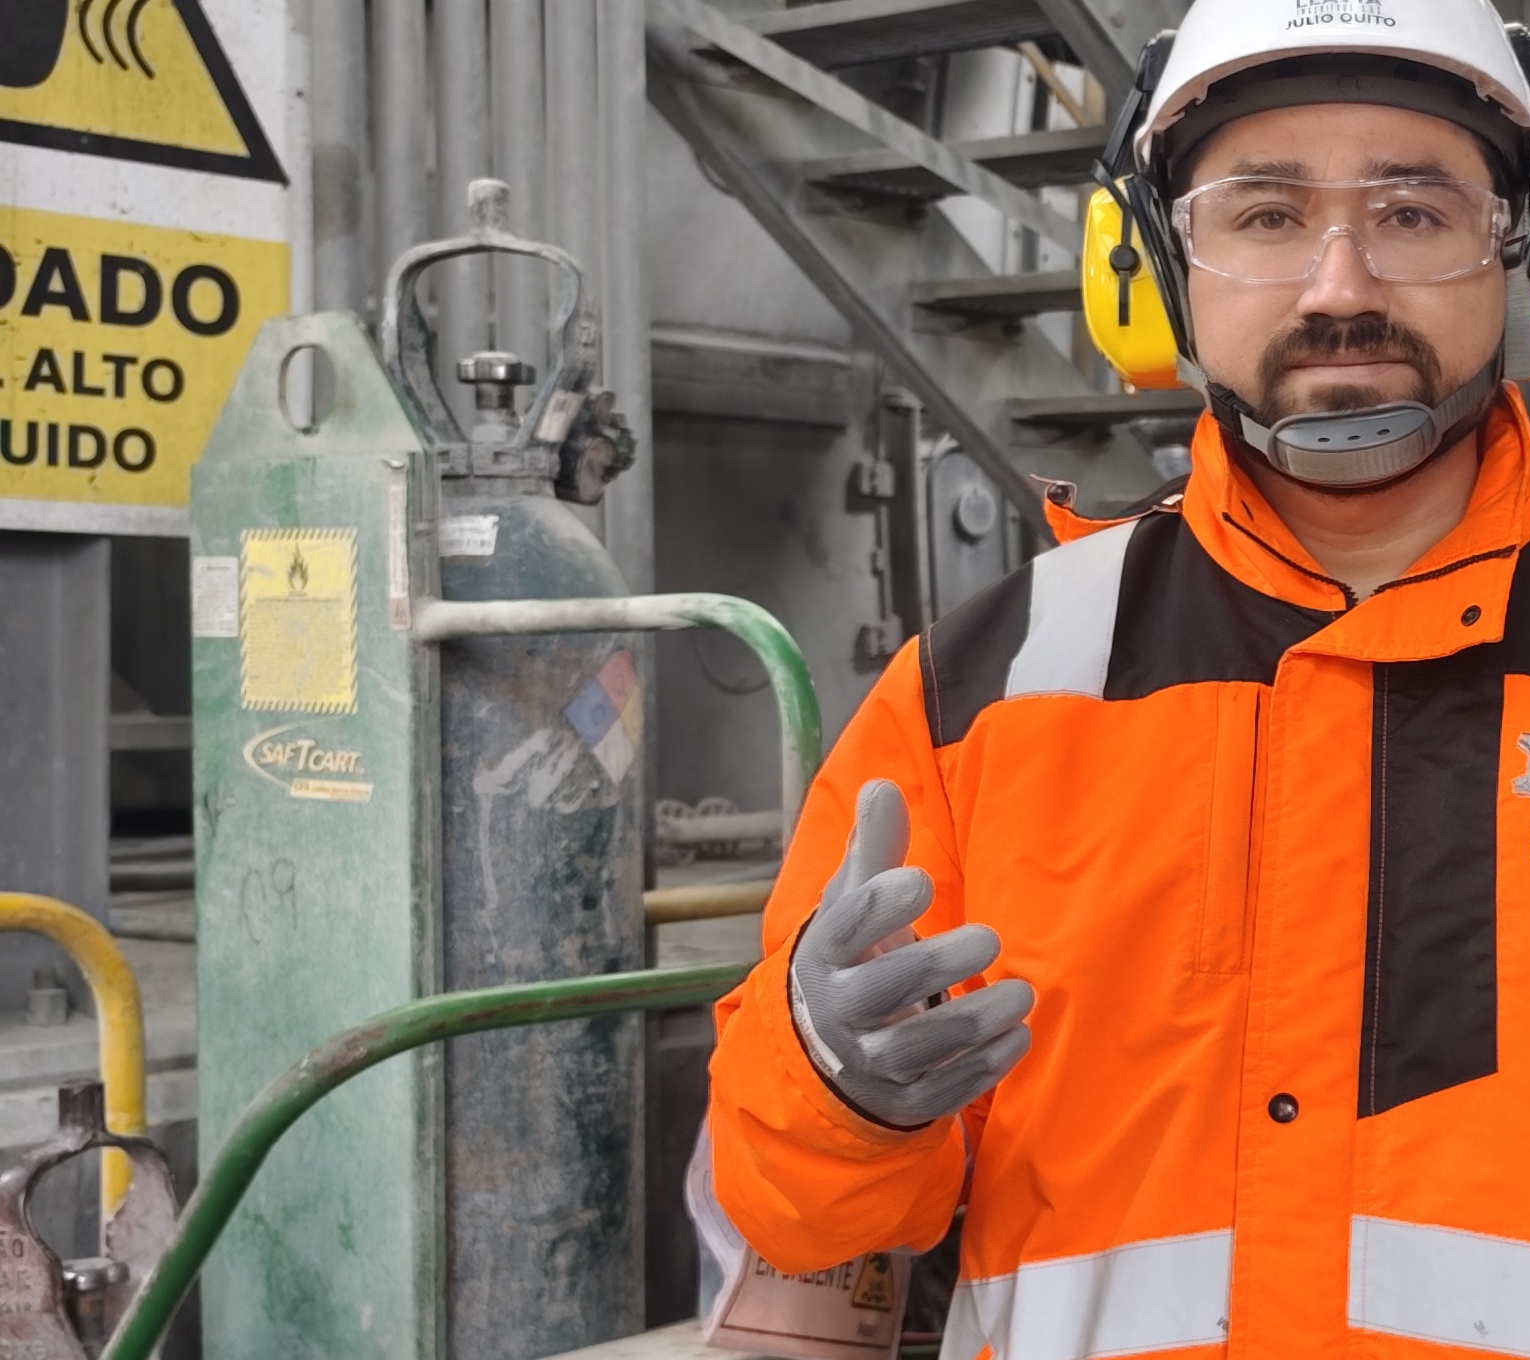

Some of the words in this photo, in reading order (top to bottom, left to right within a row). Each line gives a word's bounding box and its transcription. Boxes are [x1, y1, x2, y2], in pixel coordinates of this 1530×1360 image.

[1285, 13, 1334, 31] JULIO
[1340, 12, 1397, 28] QUITO
[0, 242, 241, 338] ADO
[24, 347, 186, 403] ALTO
